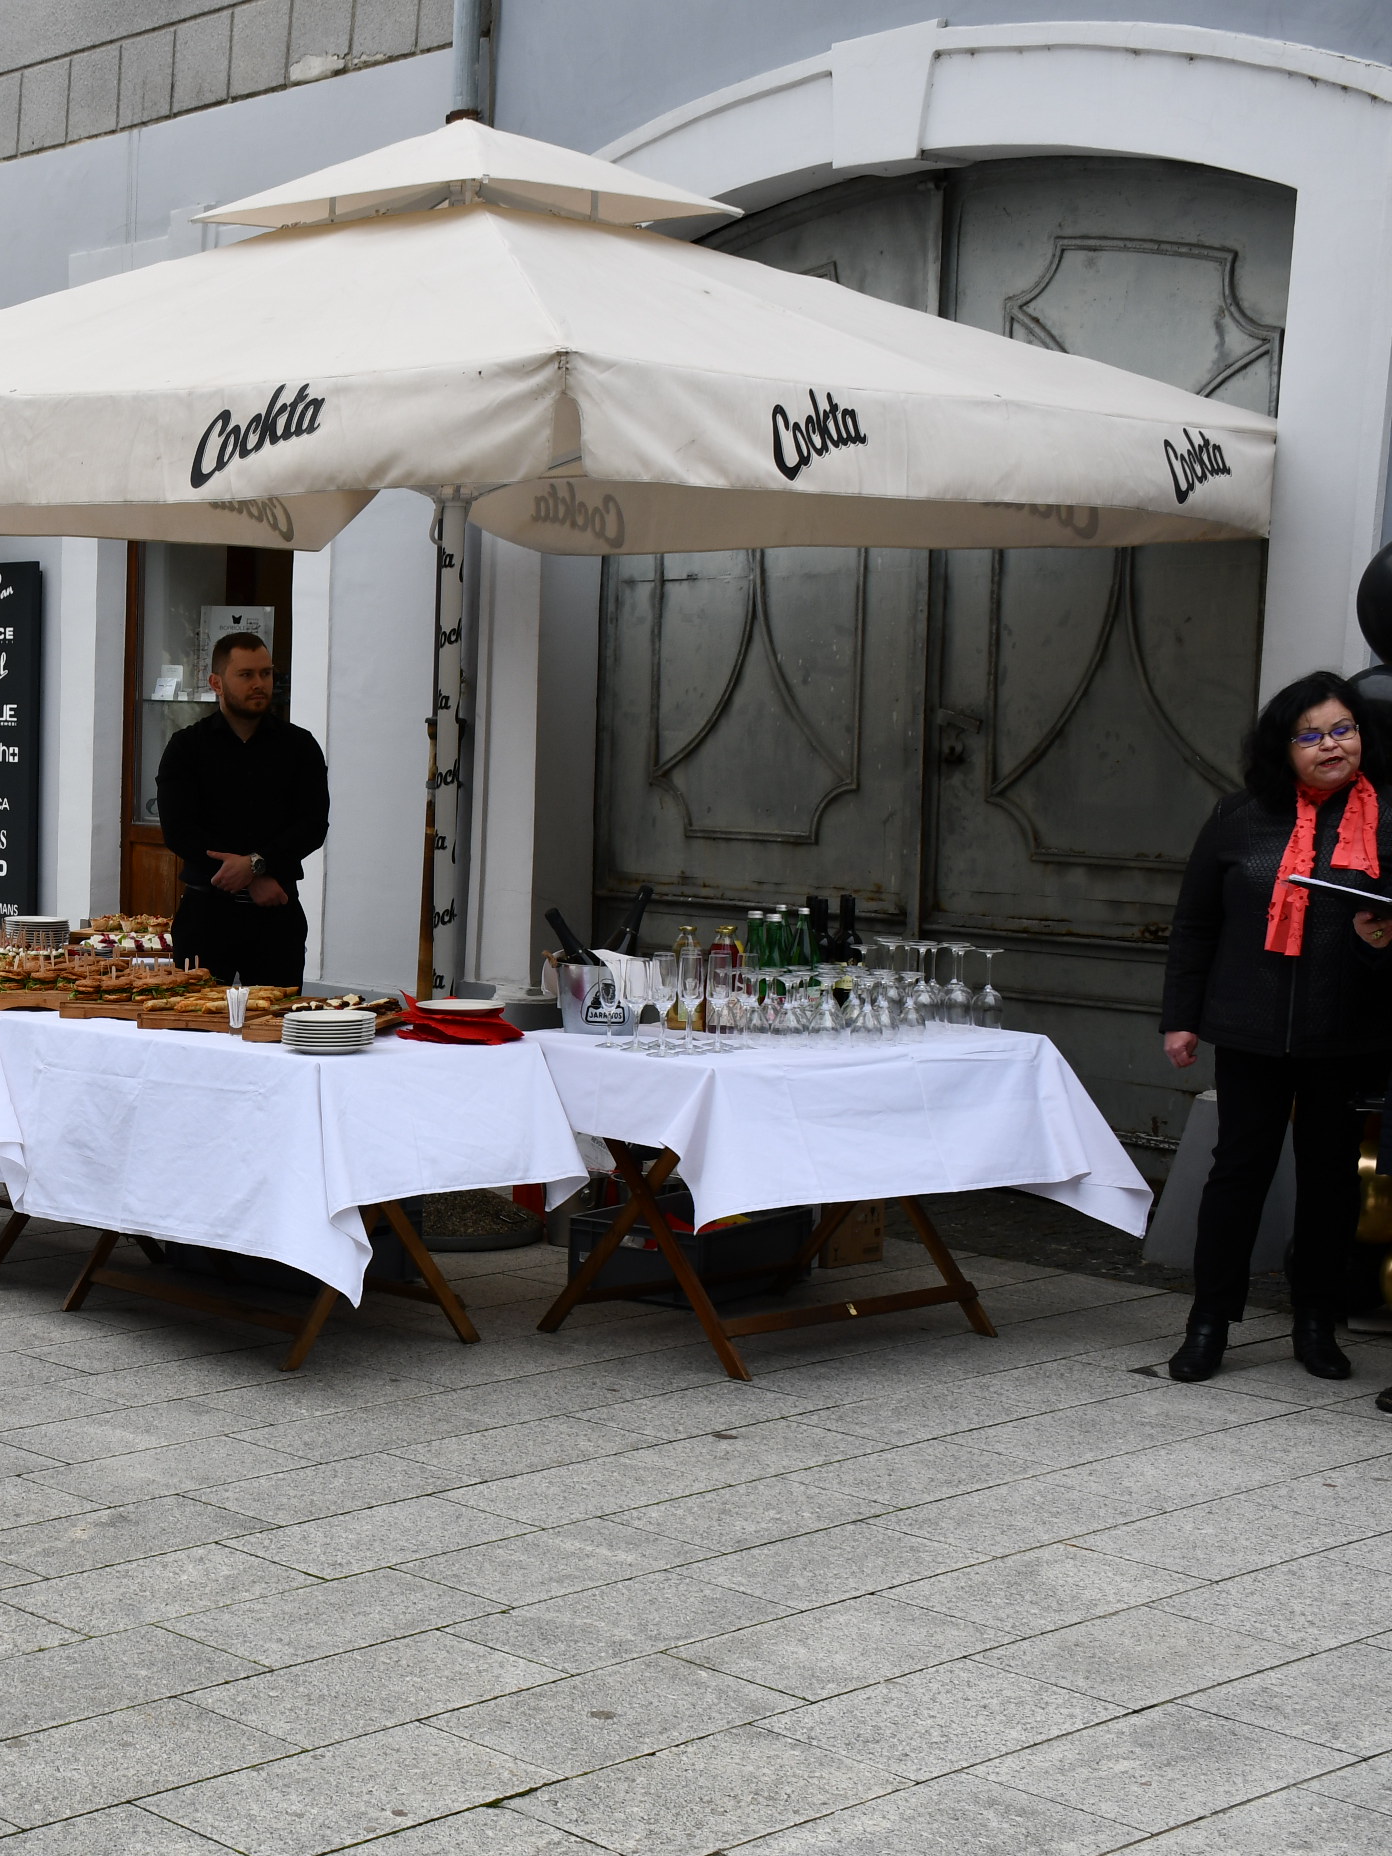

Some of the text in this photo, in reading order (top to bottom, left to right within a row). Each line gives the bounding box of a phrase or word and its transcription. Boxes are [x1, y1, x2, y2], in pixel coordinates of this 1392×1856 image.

[191, 383, 325, 489] Cockta
[771, 388, 866, 481] Cockta
[1164, 428, 1231, 504] Cockta
